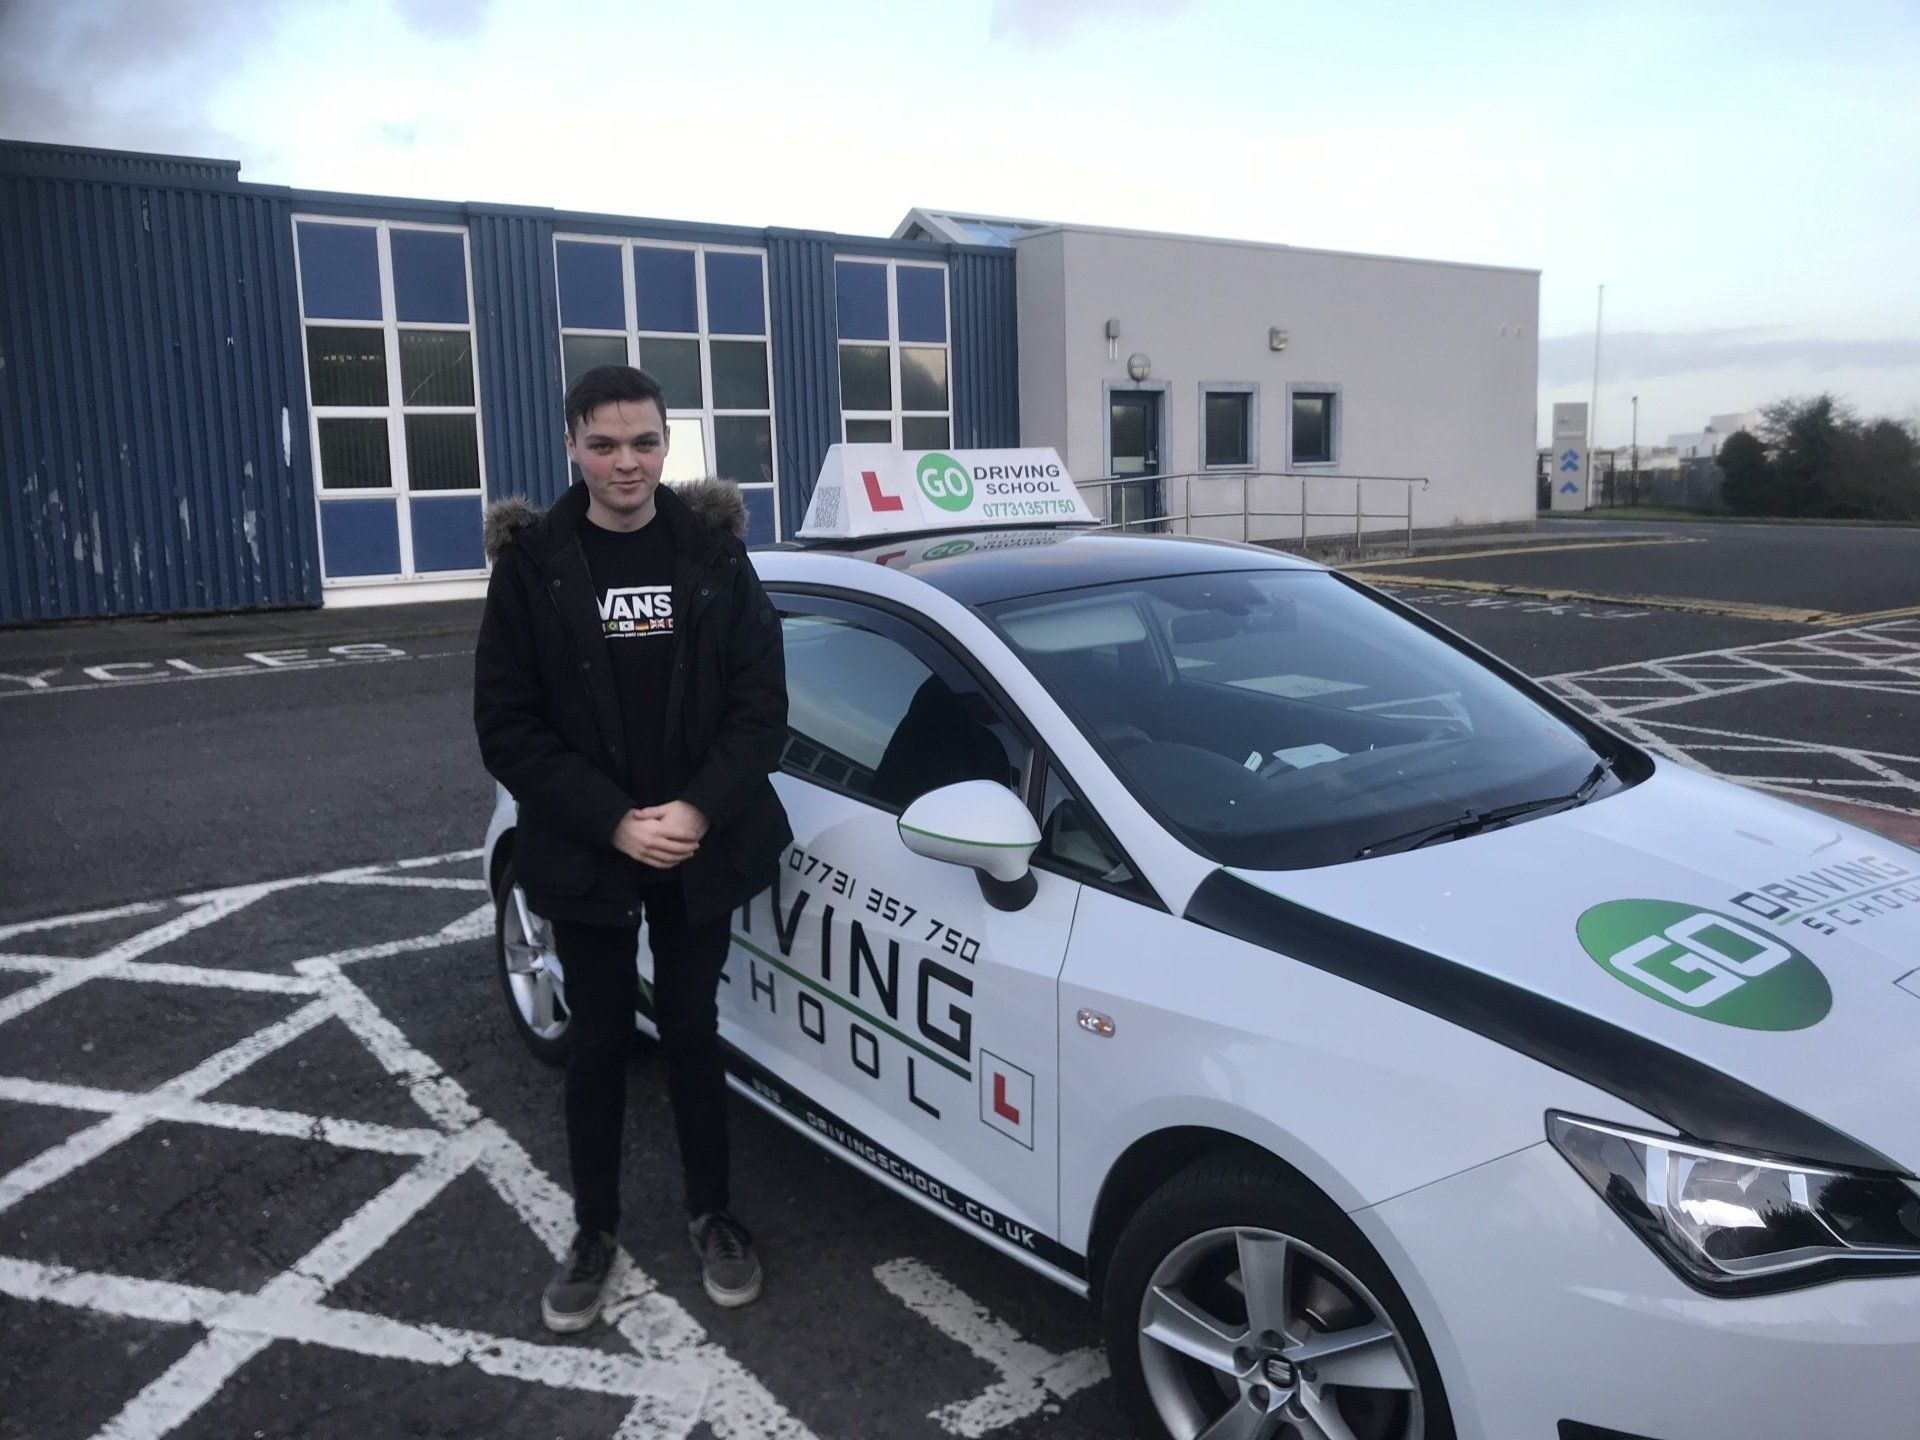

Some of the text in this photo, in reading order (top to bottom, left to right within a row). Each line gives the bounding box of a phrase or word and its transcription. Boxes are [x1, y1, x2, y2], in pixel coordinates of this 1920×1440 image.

[861, 471, 904, 512] L
[922, 464, 1060, 498] GO DRIVING
[986, 481, 1061, 495] SCHOOL
[983, 500, 1075, 518] 07731357750
[596, 585, 673, 620] VANS
[789, 848, 981, 965] 07731 357 750
[1728, 856, 1911, 920] DRIVING
[1801, 880, 1920, 936] SCHOO
[1609, 912, 1792, 1008] GO
[719, 958, 940, 1120] HOOL
[992, 1071, 1020, 1125] L
